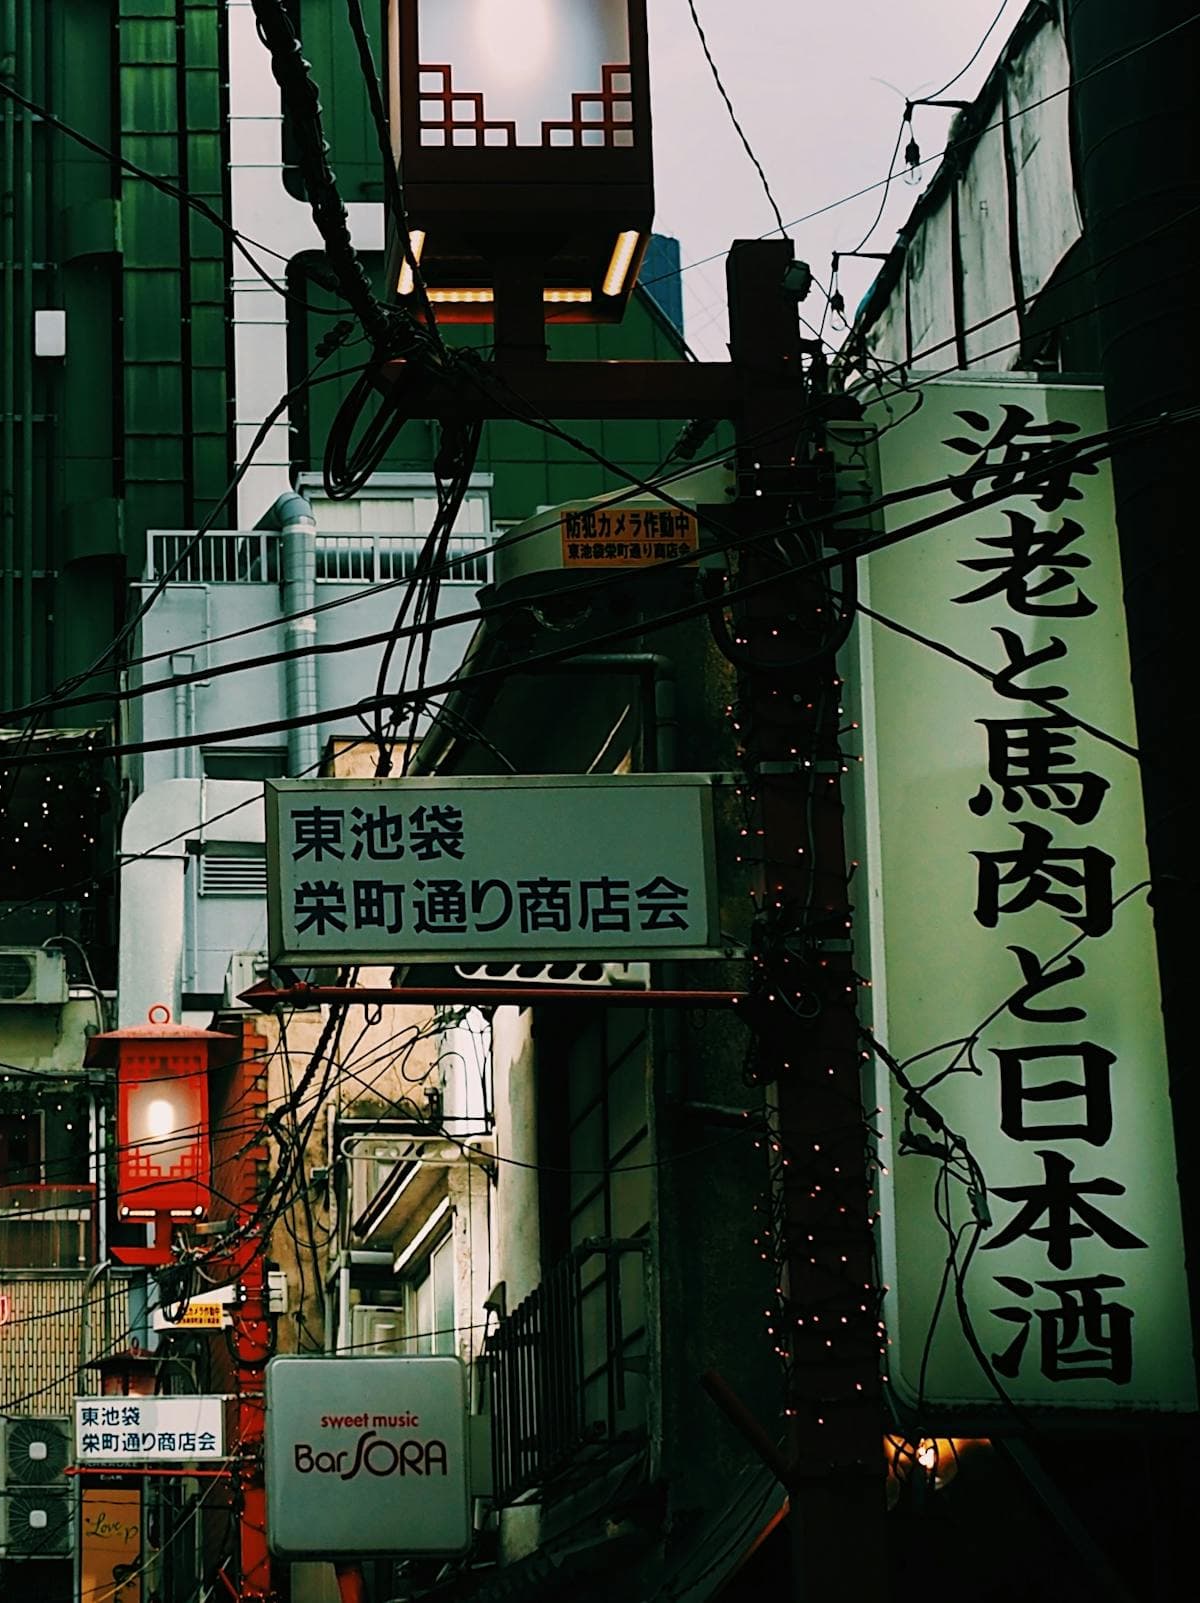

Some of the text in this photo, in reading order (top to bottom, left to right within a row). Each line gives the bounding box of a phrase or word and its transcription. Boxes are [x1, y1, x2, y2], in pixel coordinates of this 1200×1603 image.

[566, 512, 690, 538] 防犯カメラ作動中
[290, 805, 465, 862] 東池袋
[294, 876, 690, 935] 栄町通り商店会
[941, 404, 1149, 1385] 海老と馬肉と日本酒
[81, 1407, 140, 1426] 東池袋
[321, 1410, 419, 1429] sweet music
[82, 1432, 216, 1452] 栄町通り商店会
[295, 1430, 448, 1481] Bar SORA
